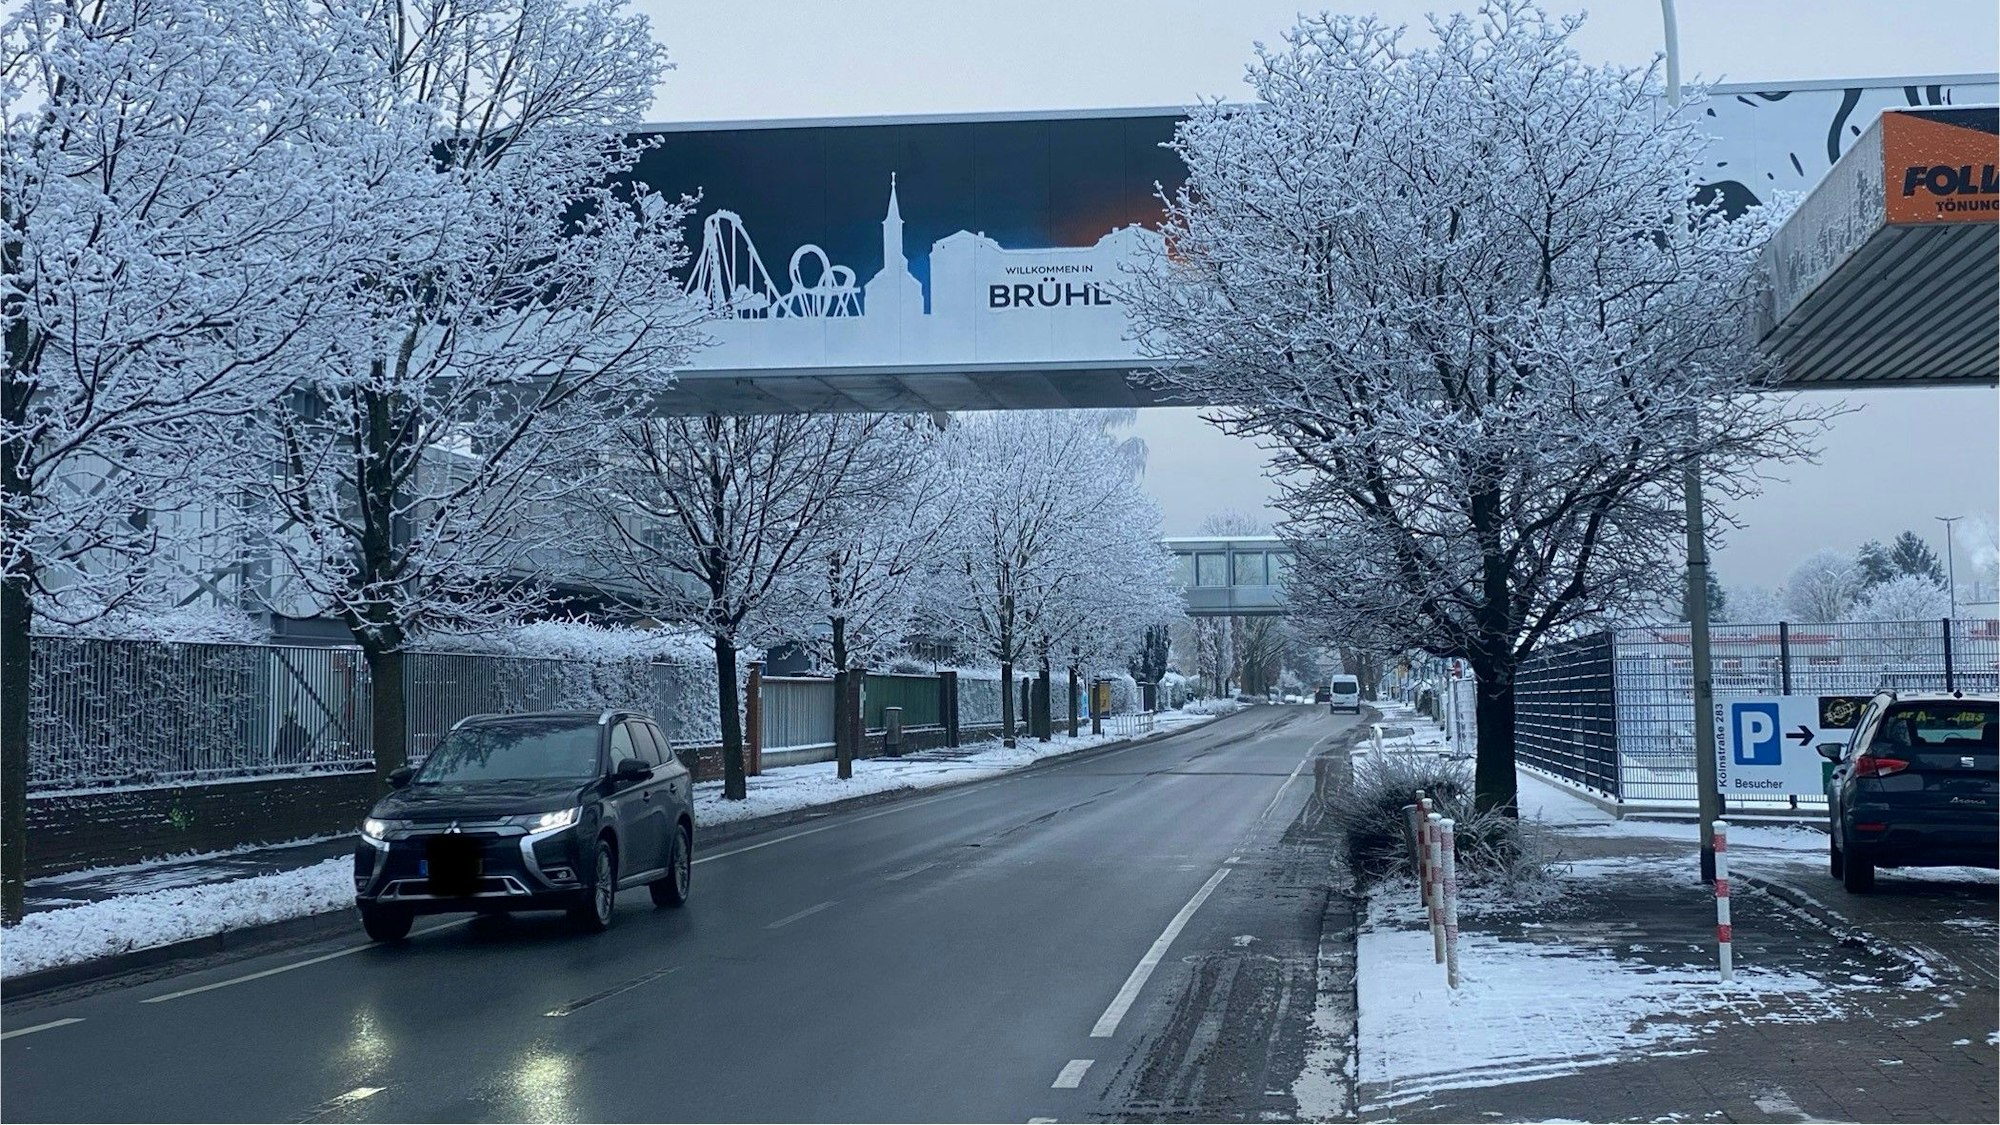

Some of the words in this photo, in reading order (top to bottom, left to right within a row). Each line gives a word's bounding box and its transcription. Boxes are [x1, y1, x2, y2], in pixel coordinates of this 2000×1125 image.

[1005, 265, 1080, 275] WILLKOMMEN
[1082, 264, 1093, 273] IN
[989, 277, 1111, 308] BRÜHL
[1715, 703, 1725, 723] 283
[1740, 711, 1774, 759] P
[1716, 727, 1728, 788] Kölnstraße
[1735, 778, 1784, 789] Besucher
